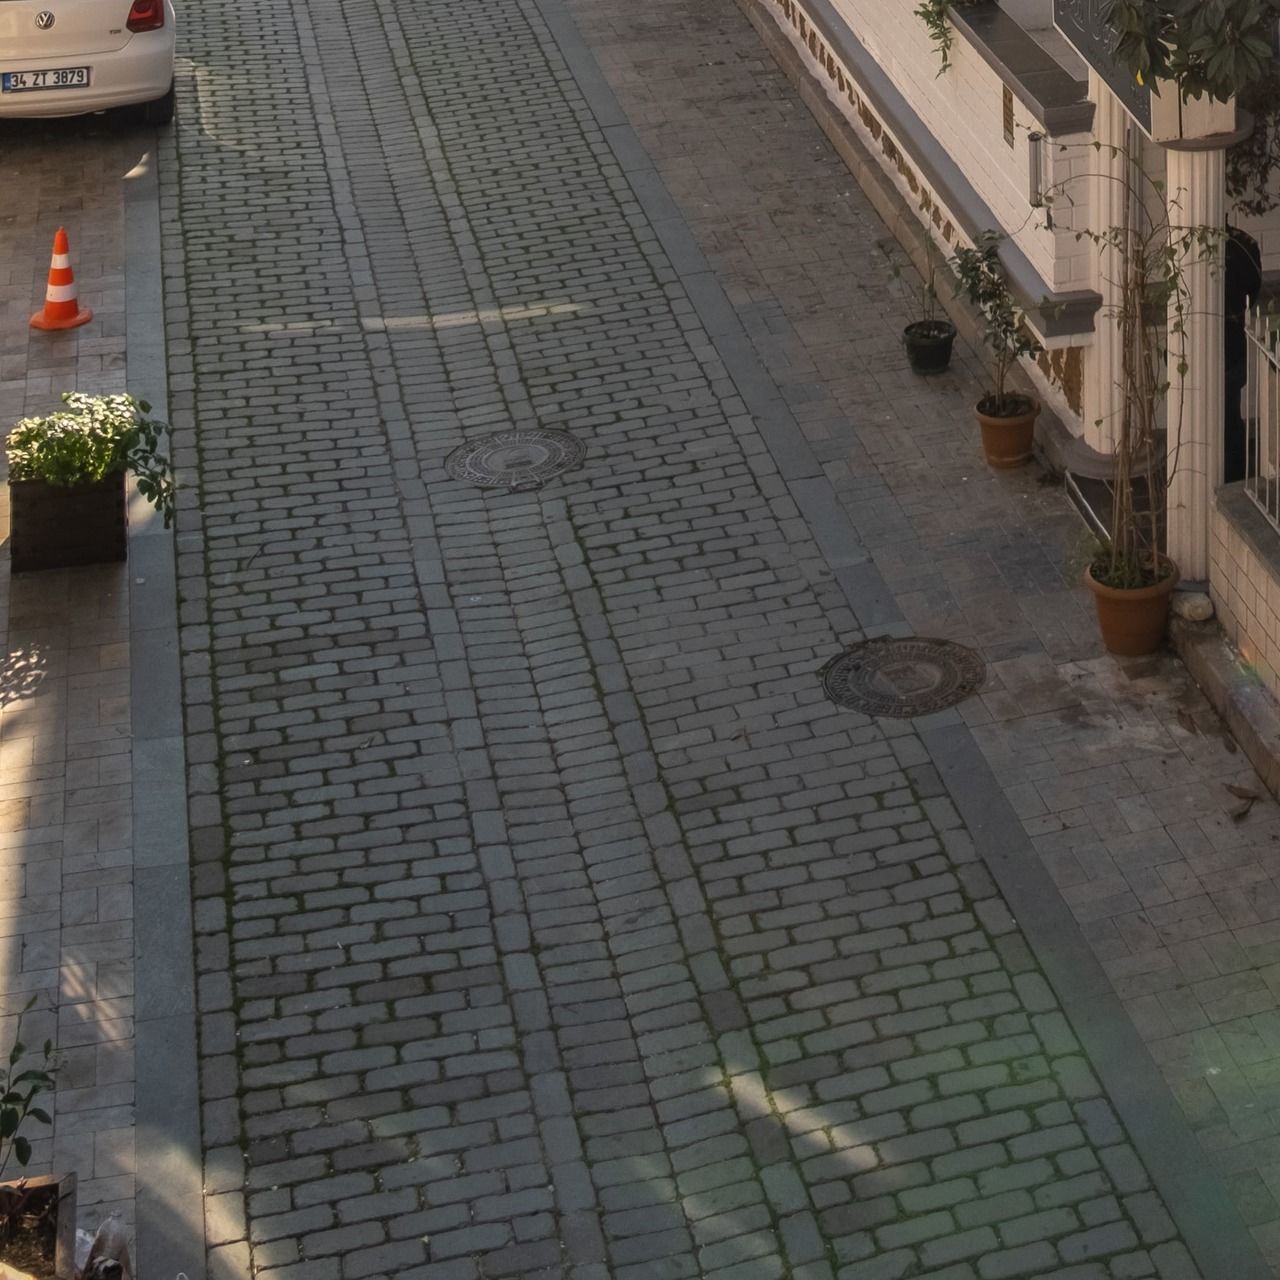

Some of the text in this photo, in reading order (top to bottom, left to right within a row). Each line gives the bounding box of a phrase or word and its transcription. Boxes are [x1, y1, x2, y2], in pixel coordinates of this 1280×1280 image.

[11, 74, 27, 88] 34
[33, 72, 48, 86] ZT
[53, 69, 84, 85] 3879
